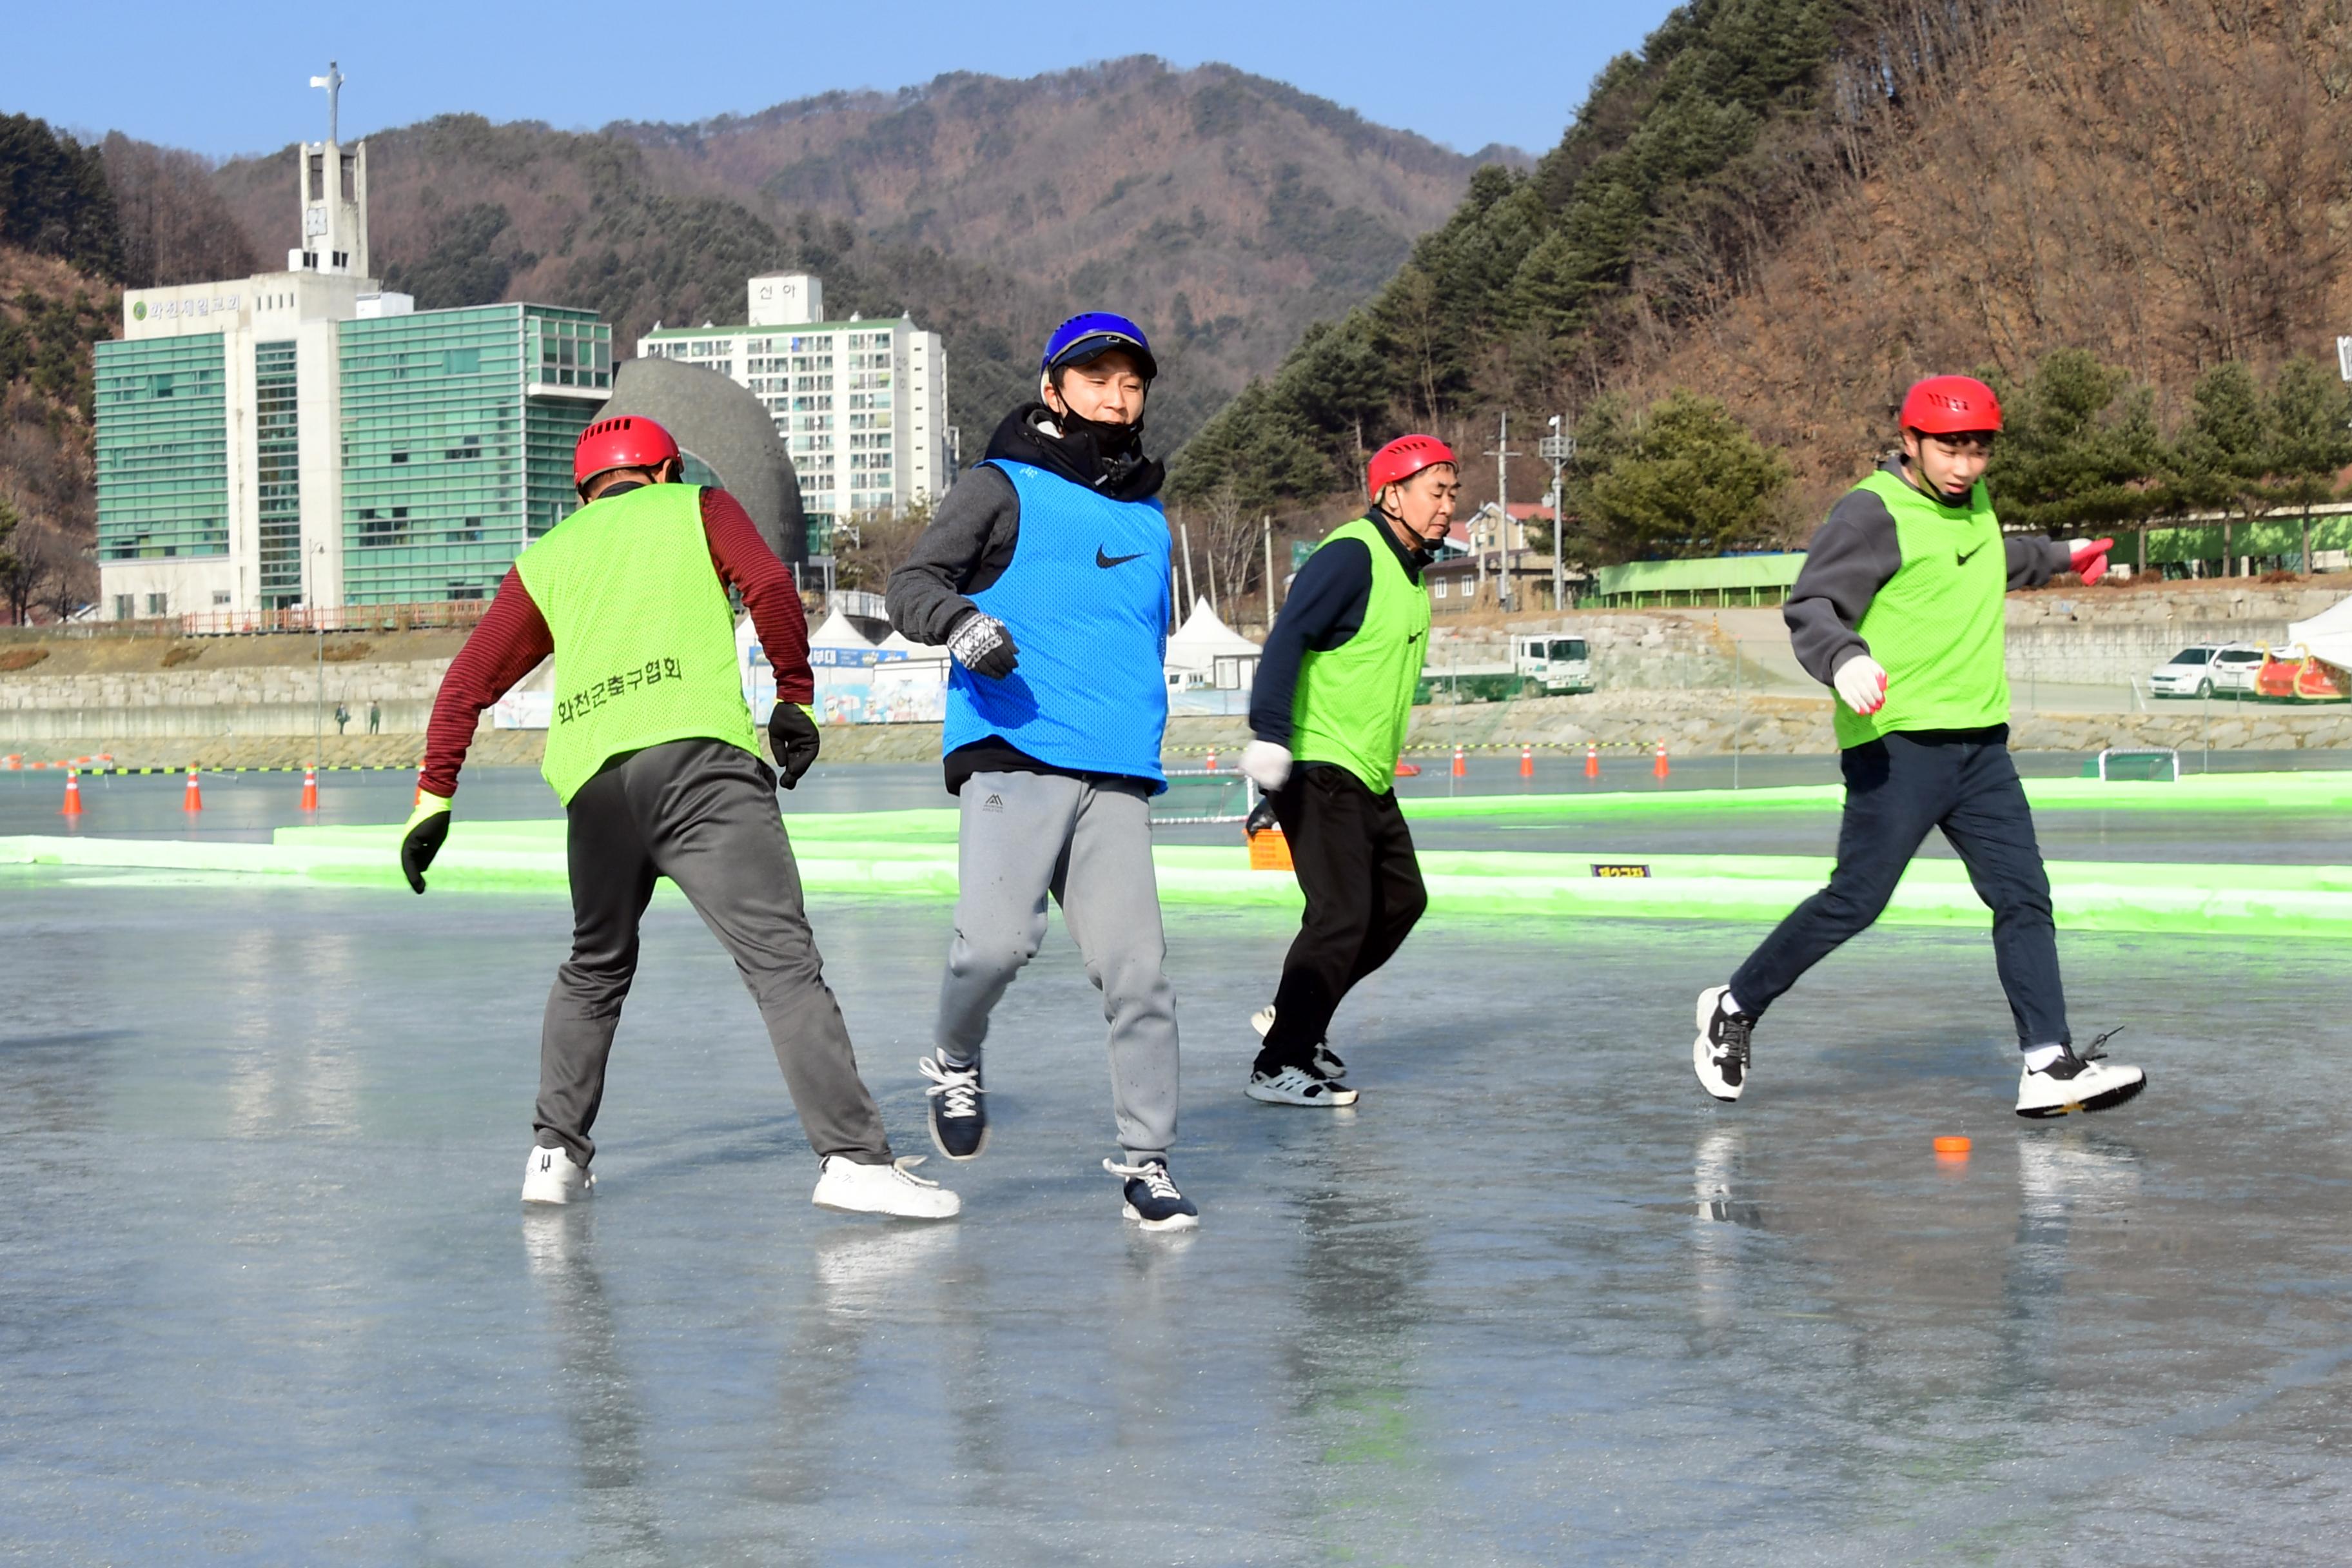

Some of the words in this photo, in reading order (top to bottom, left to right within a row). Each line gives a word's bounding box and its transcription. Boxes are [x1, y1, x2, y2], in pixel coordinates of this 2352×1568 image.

[760, 284, 796, 300] 신아
[150, 295, 240, 320] 화천제일교회
[558, 657, 682, 725] 화천군축구협회
